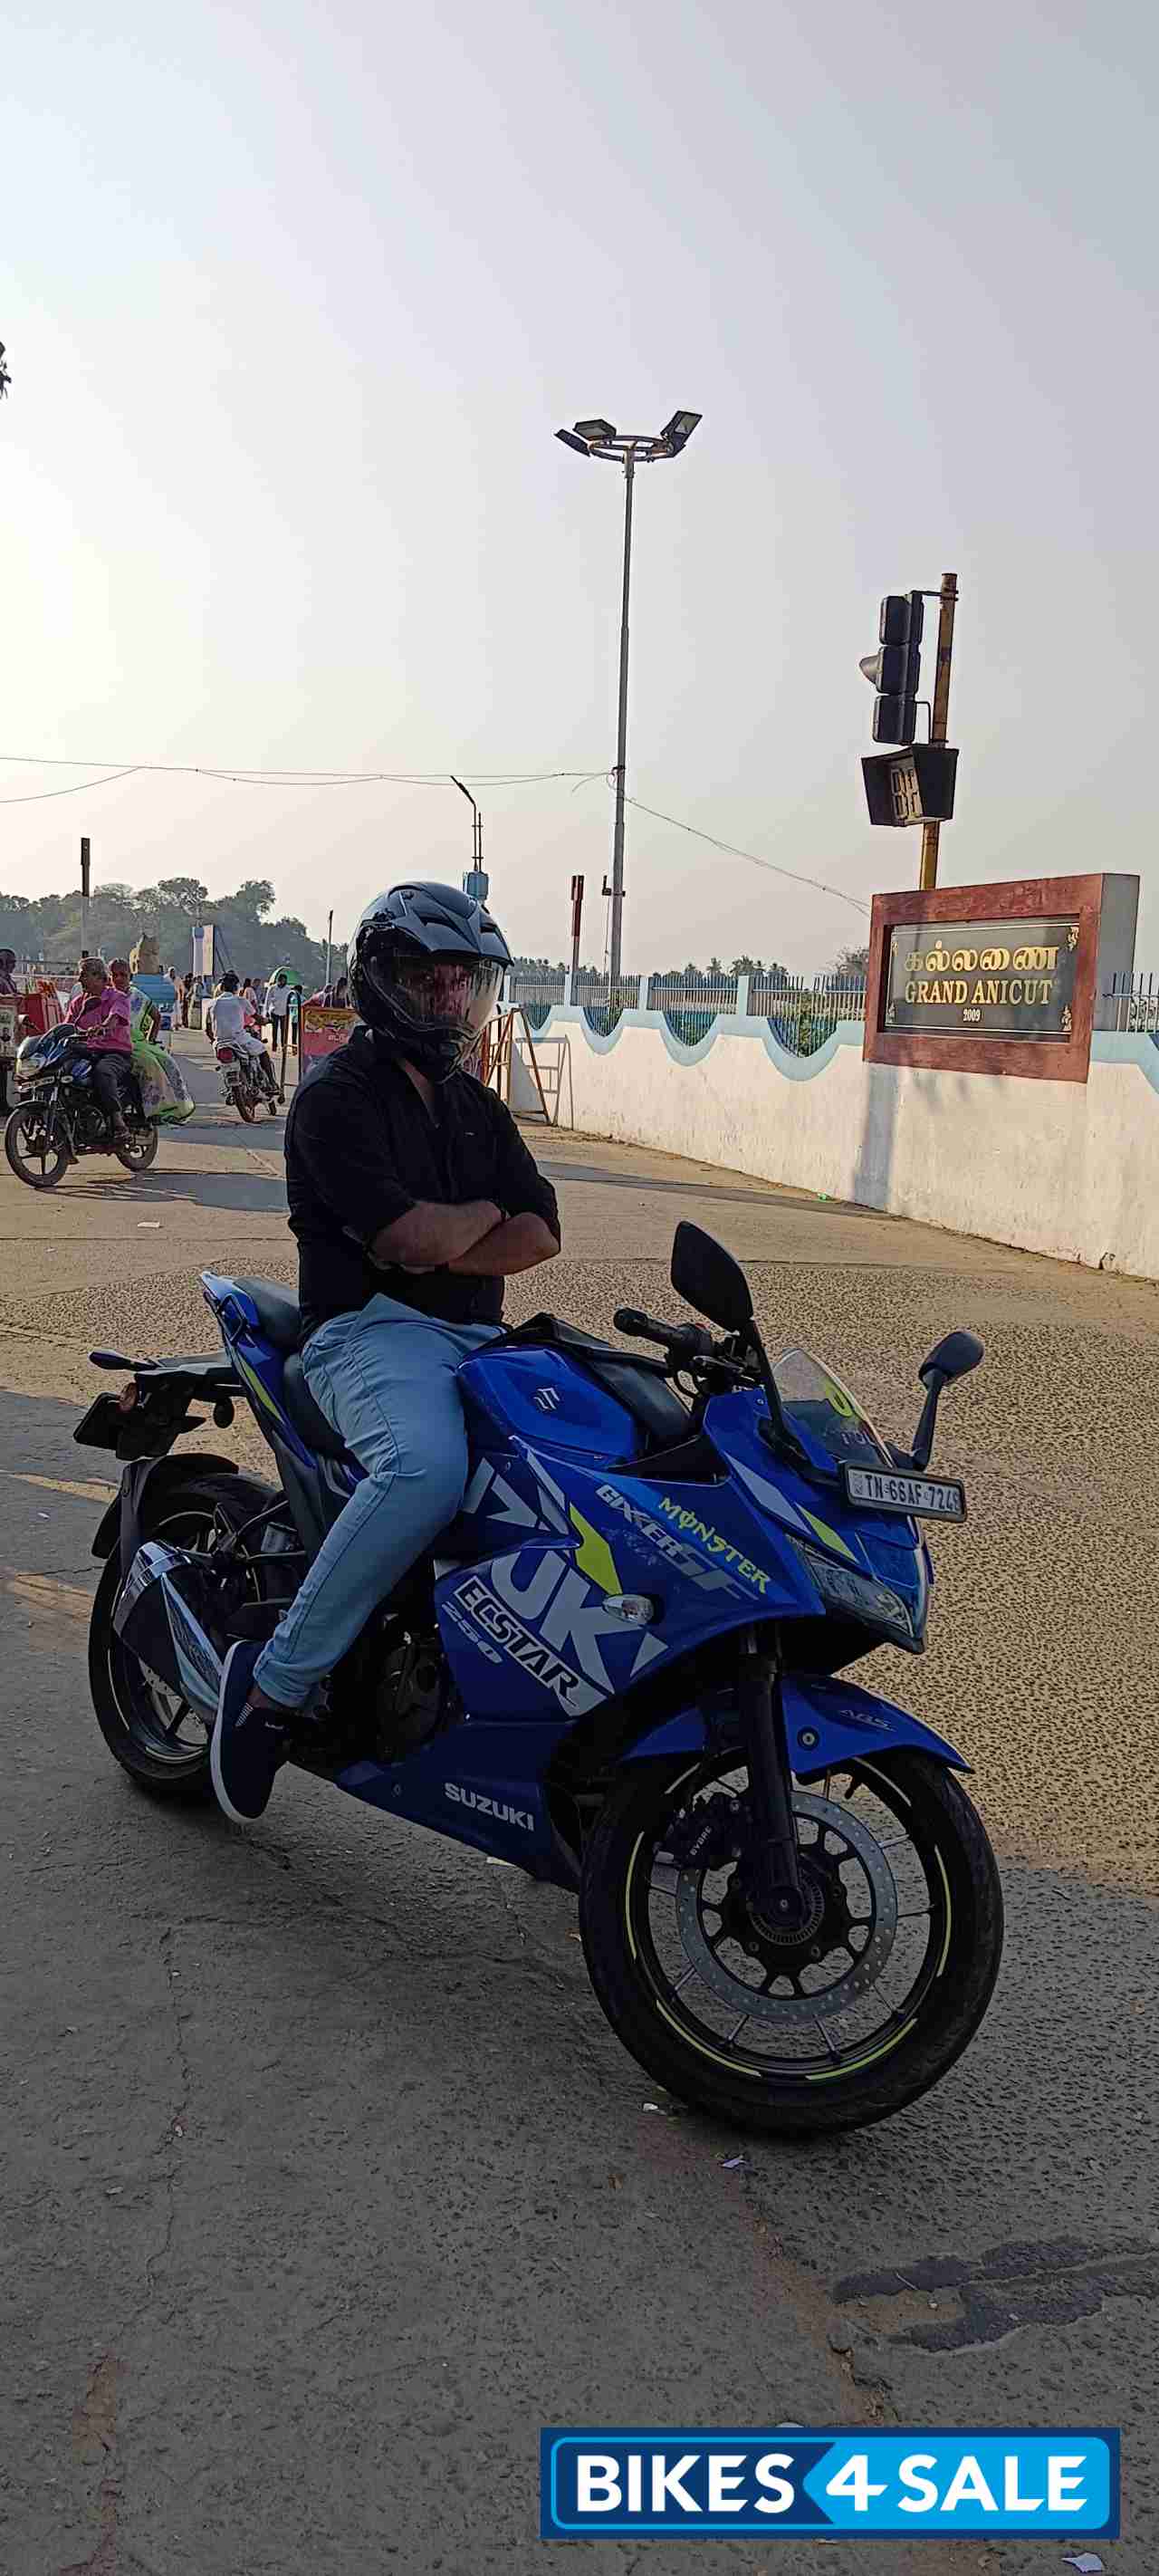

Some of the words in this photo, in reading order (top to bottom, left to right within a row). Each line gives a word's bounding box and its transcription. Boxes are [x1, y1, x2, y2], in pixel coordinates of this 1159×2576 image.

[904, 940, 1059, 972] கல்லணை
[905, 979, 968, 1004] GRAND
[971, 978, 1053, 1004] ANICUT
[963, 1008, 982, 1023] 2009
[456, 1579, 580, 1708] ECSTAR
[444, 1782, 534, 1831] SUZUKI
